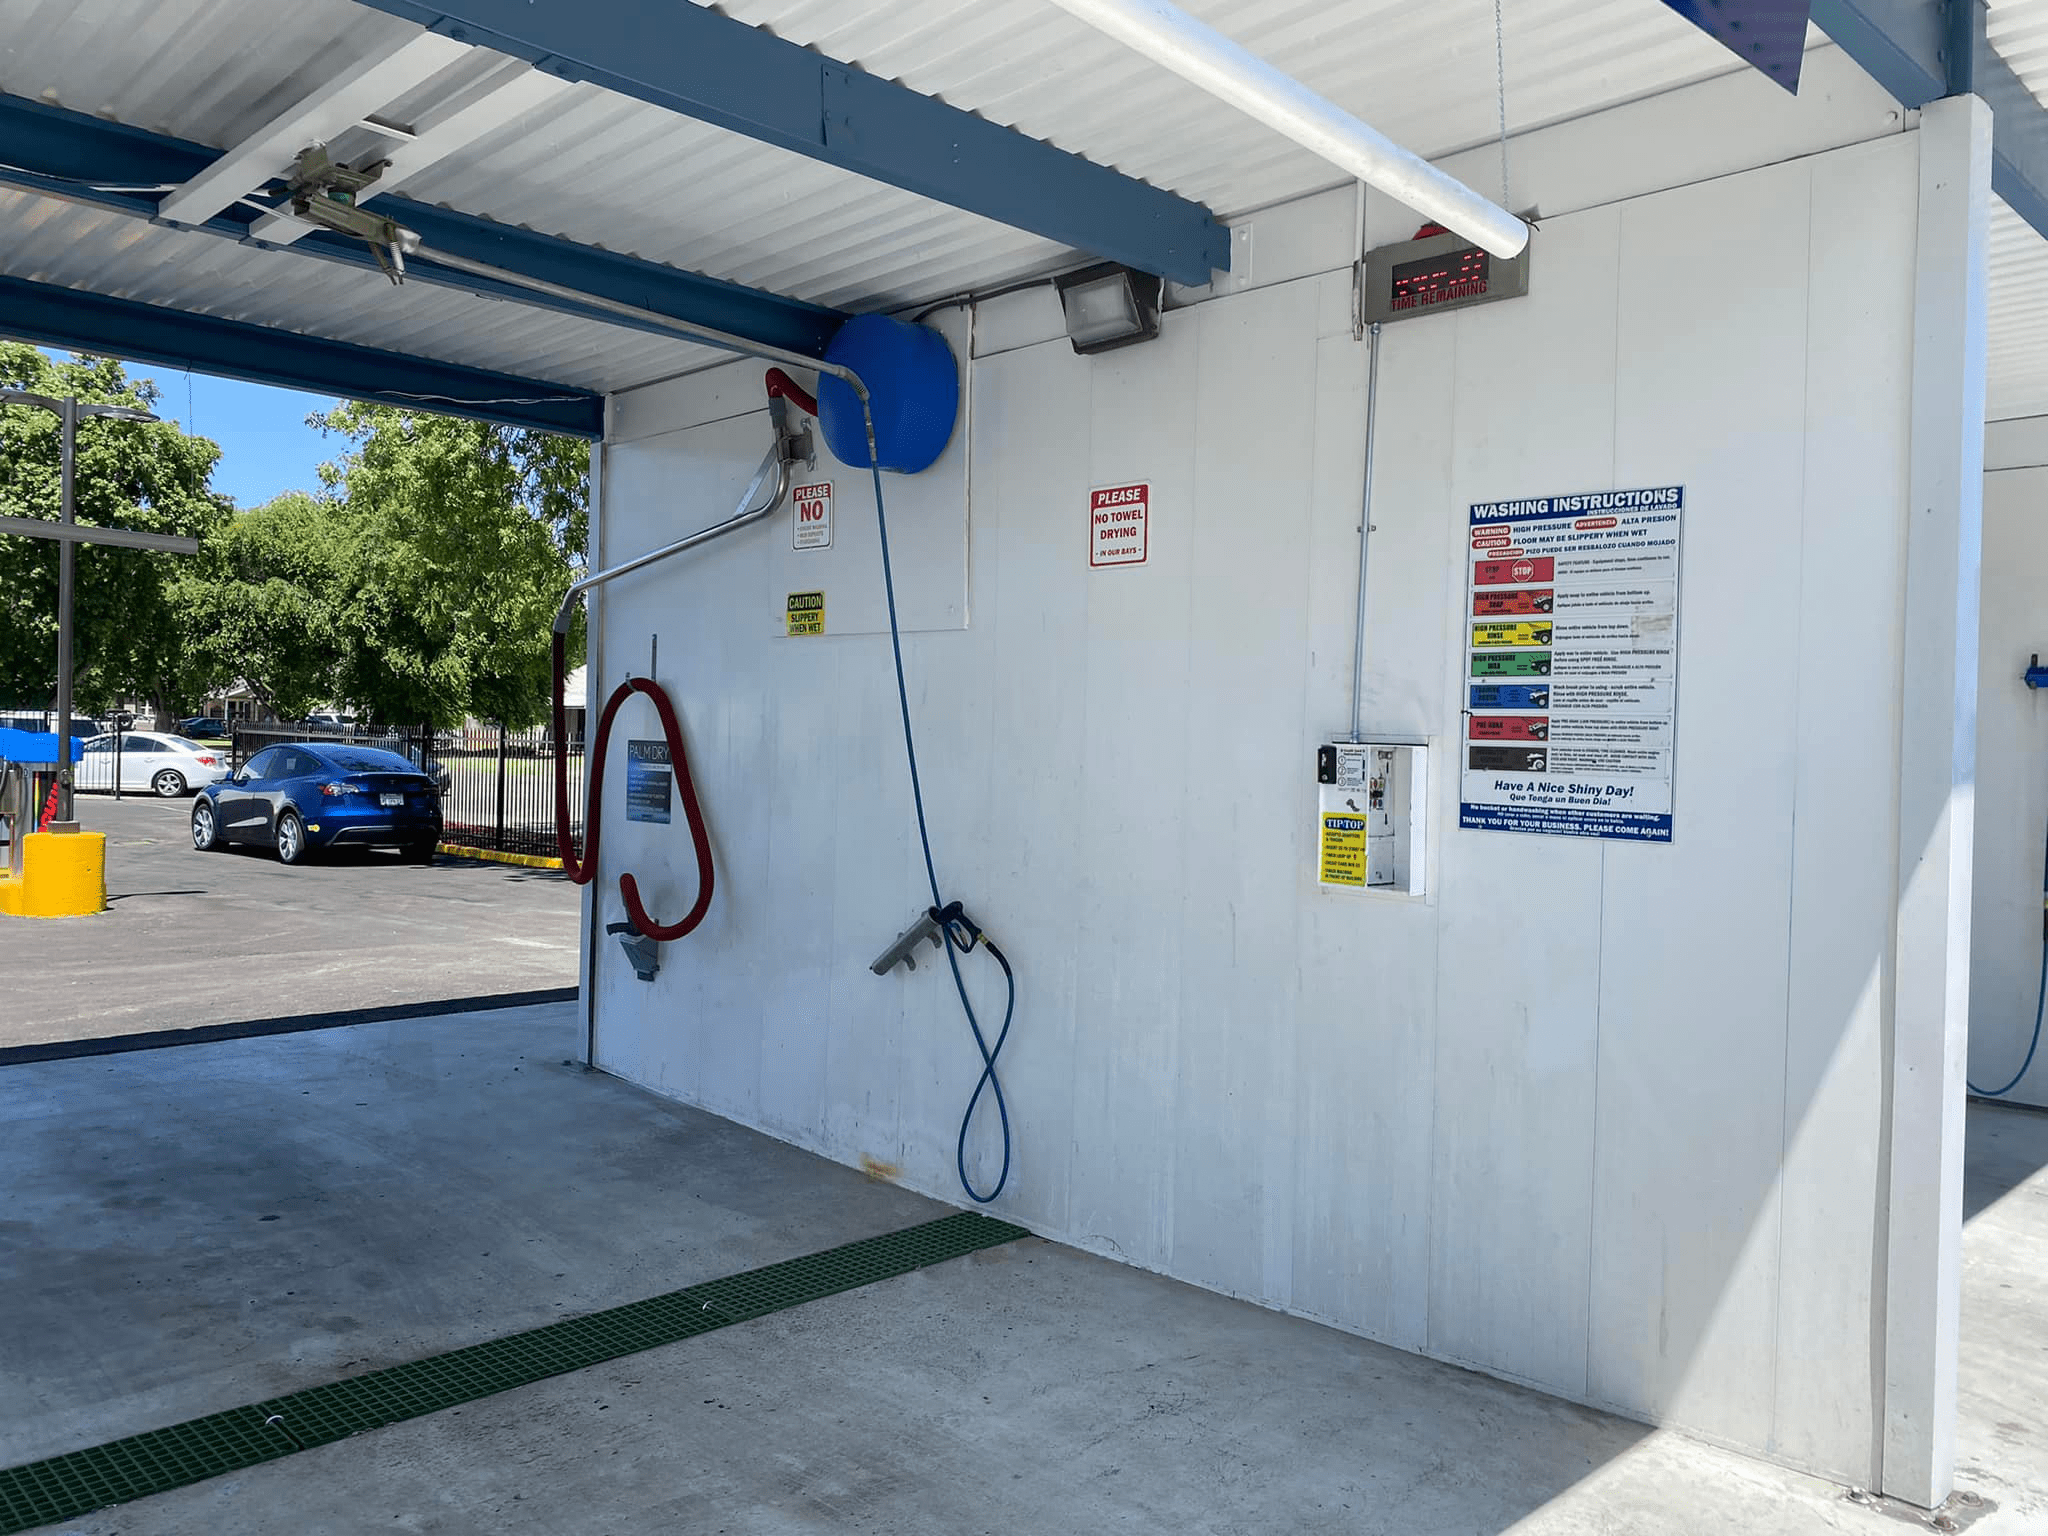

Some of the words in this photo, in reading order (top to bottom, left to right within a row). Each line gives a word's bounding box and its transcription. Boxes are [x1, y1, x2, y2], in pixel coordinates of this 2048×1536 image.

[1392, 295, 1417, 310] TIME
[1421, 280, 1488, 304] REMAINING
[796, 485, 828, 500] PLEASE
[1098, 488, 1141, 505] PLEASE
[1473, 499, 1549, 519] WASHING
[1552, 487, 1679, 513] INSTRUCTIONS
[1640, 504, 1650, 512] DE
[1650, 502, 1678, 511] LAVADO
[800, 500, 823, 522] NO
[1095, 513, 1109, 525] NO
[1111, 509, 1143, 523] TOWEL
[1474, 527, 1509, 537] WARNING
[1512, 526, 1531, 534] HIGH
[1532, 522, 1572, 532] PRESSURE
[1621, 517, 1639, 525] ALTA
[1641, 514, 1677, 524] PRESION
[1100, 526, 1137, 540] DRYING
[1475, 538, 1507, 547] CAUTION
[1513, 537, 1537, 545] FLOOR
[1538, 535, 1555, 543] MAY
[1567, 531, 1604, 542] SLIPPERY
[1605, 530, 1629, 539] WHEN
[1630, 528, 1648, 537] WET
[1618, 541, 1646, 549] CUANDO
[1647, 538, 1676, 547] MOJADO
[1100, 549, 1106, 557] IN
[1107, 548, 1120, 556] OUR
[1121, 547, 1137, 555] BAYS
[1514, 565, 1532, 576] STOP
[789, 595, 822, 609] CAUTION
[791, 612, 819, 623] SLIPPERY
[789, 623, 807, 633] WHEN
[808, 622, 821, 632] WET
[1494, 780, 1524, 791] Have
[1526, 782, 1535, 792] A
[1537, 782, 1565, 793] Nice
[1568, 783, 1603, 797] Shiny
[1605, 785, 1634, 798] Day!
[1509, 793, 1526, 801] Que
[1528, 794, 1553, 803] Tenga
[1568, 796, 1590, 804] Buen
[1509, 805, 1549, 815] handwashing
[1586, 811, 1620, 819] customers
[1462, 816, 1486, 825] THANK
[1487, 817, 1503, 825] YOU
[1503, 818, 1519, 826] FOR
[1520, 819, 1541, 828] YOUR
[1583, 824, 1614, 833] PLEASE
[1615, 826, 1639, 835] COME
[1640, 827, 1669, 837] AGAIN!
